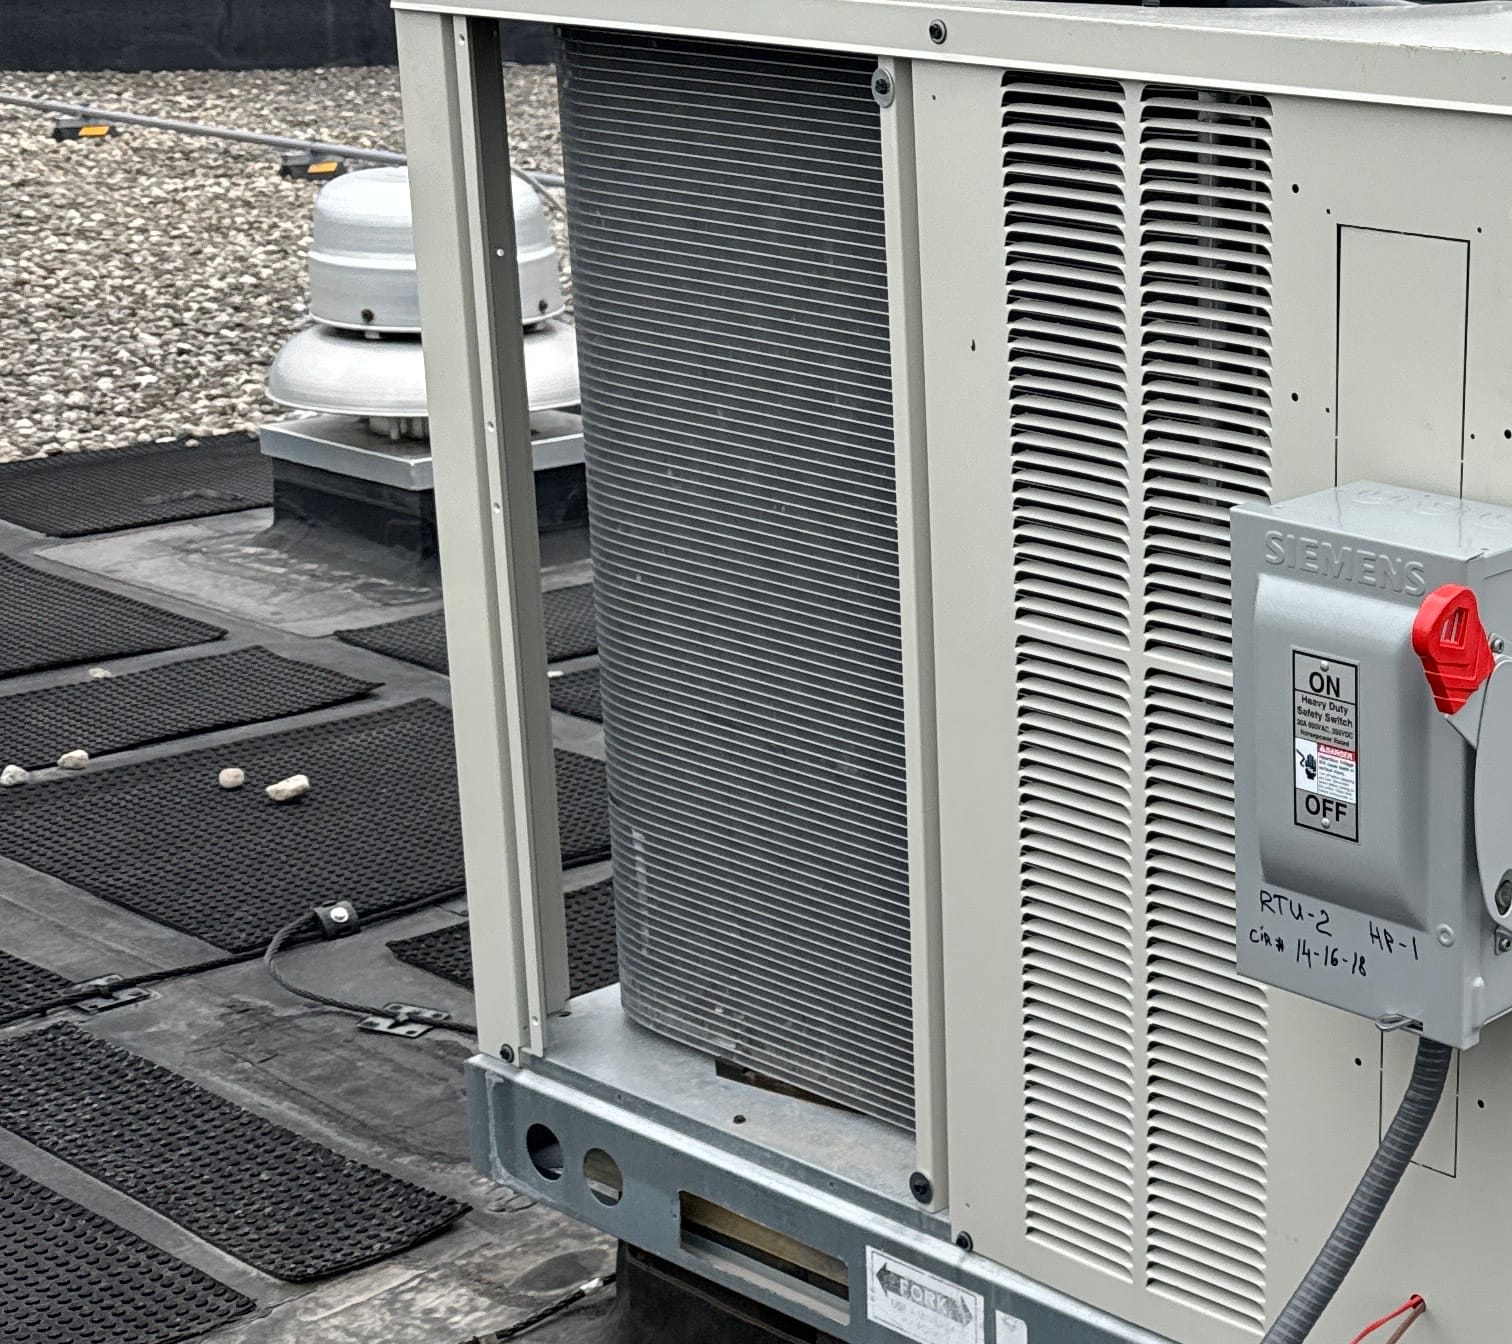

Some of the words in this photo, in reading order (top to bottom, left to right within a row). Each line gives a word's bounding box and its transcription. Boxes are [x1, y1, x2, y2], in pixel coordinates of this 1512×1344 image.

[1265, 530, 1426, 597] SIEMENS
[1309, 671, 1340, 698] ON
[1297, 706, 1322, 721] Safety
[1325, 713, 1353, 728] Switch
[1301, 695, 1326, 710] Heavy
[1329, 702, 1348, 716] Duty
[1305, 794, 1348, 822] OFF
[1259, 890, 1333, 937] RTU-2
[1296, 939, 1367, 976] 14-16-18
[900, 1278, 949, 1316] FORK
